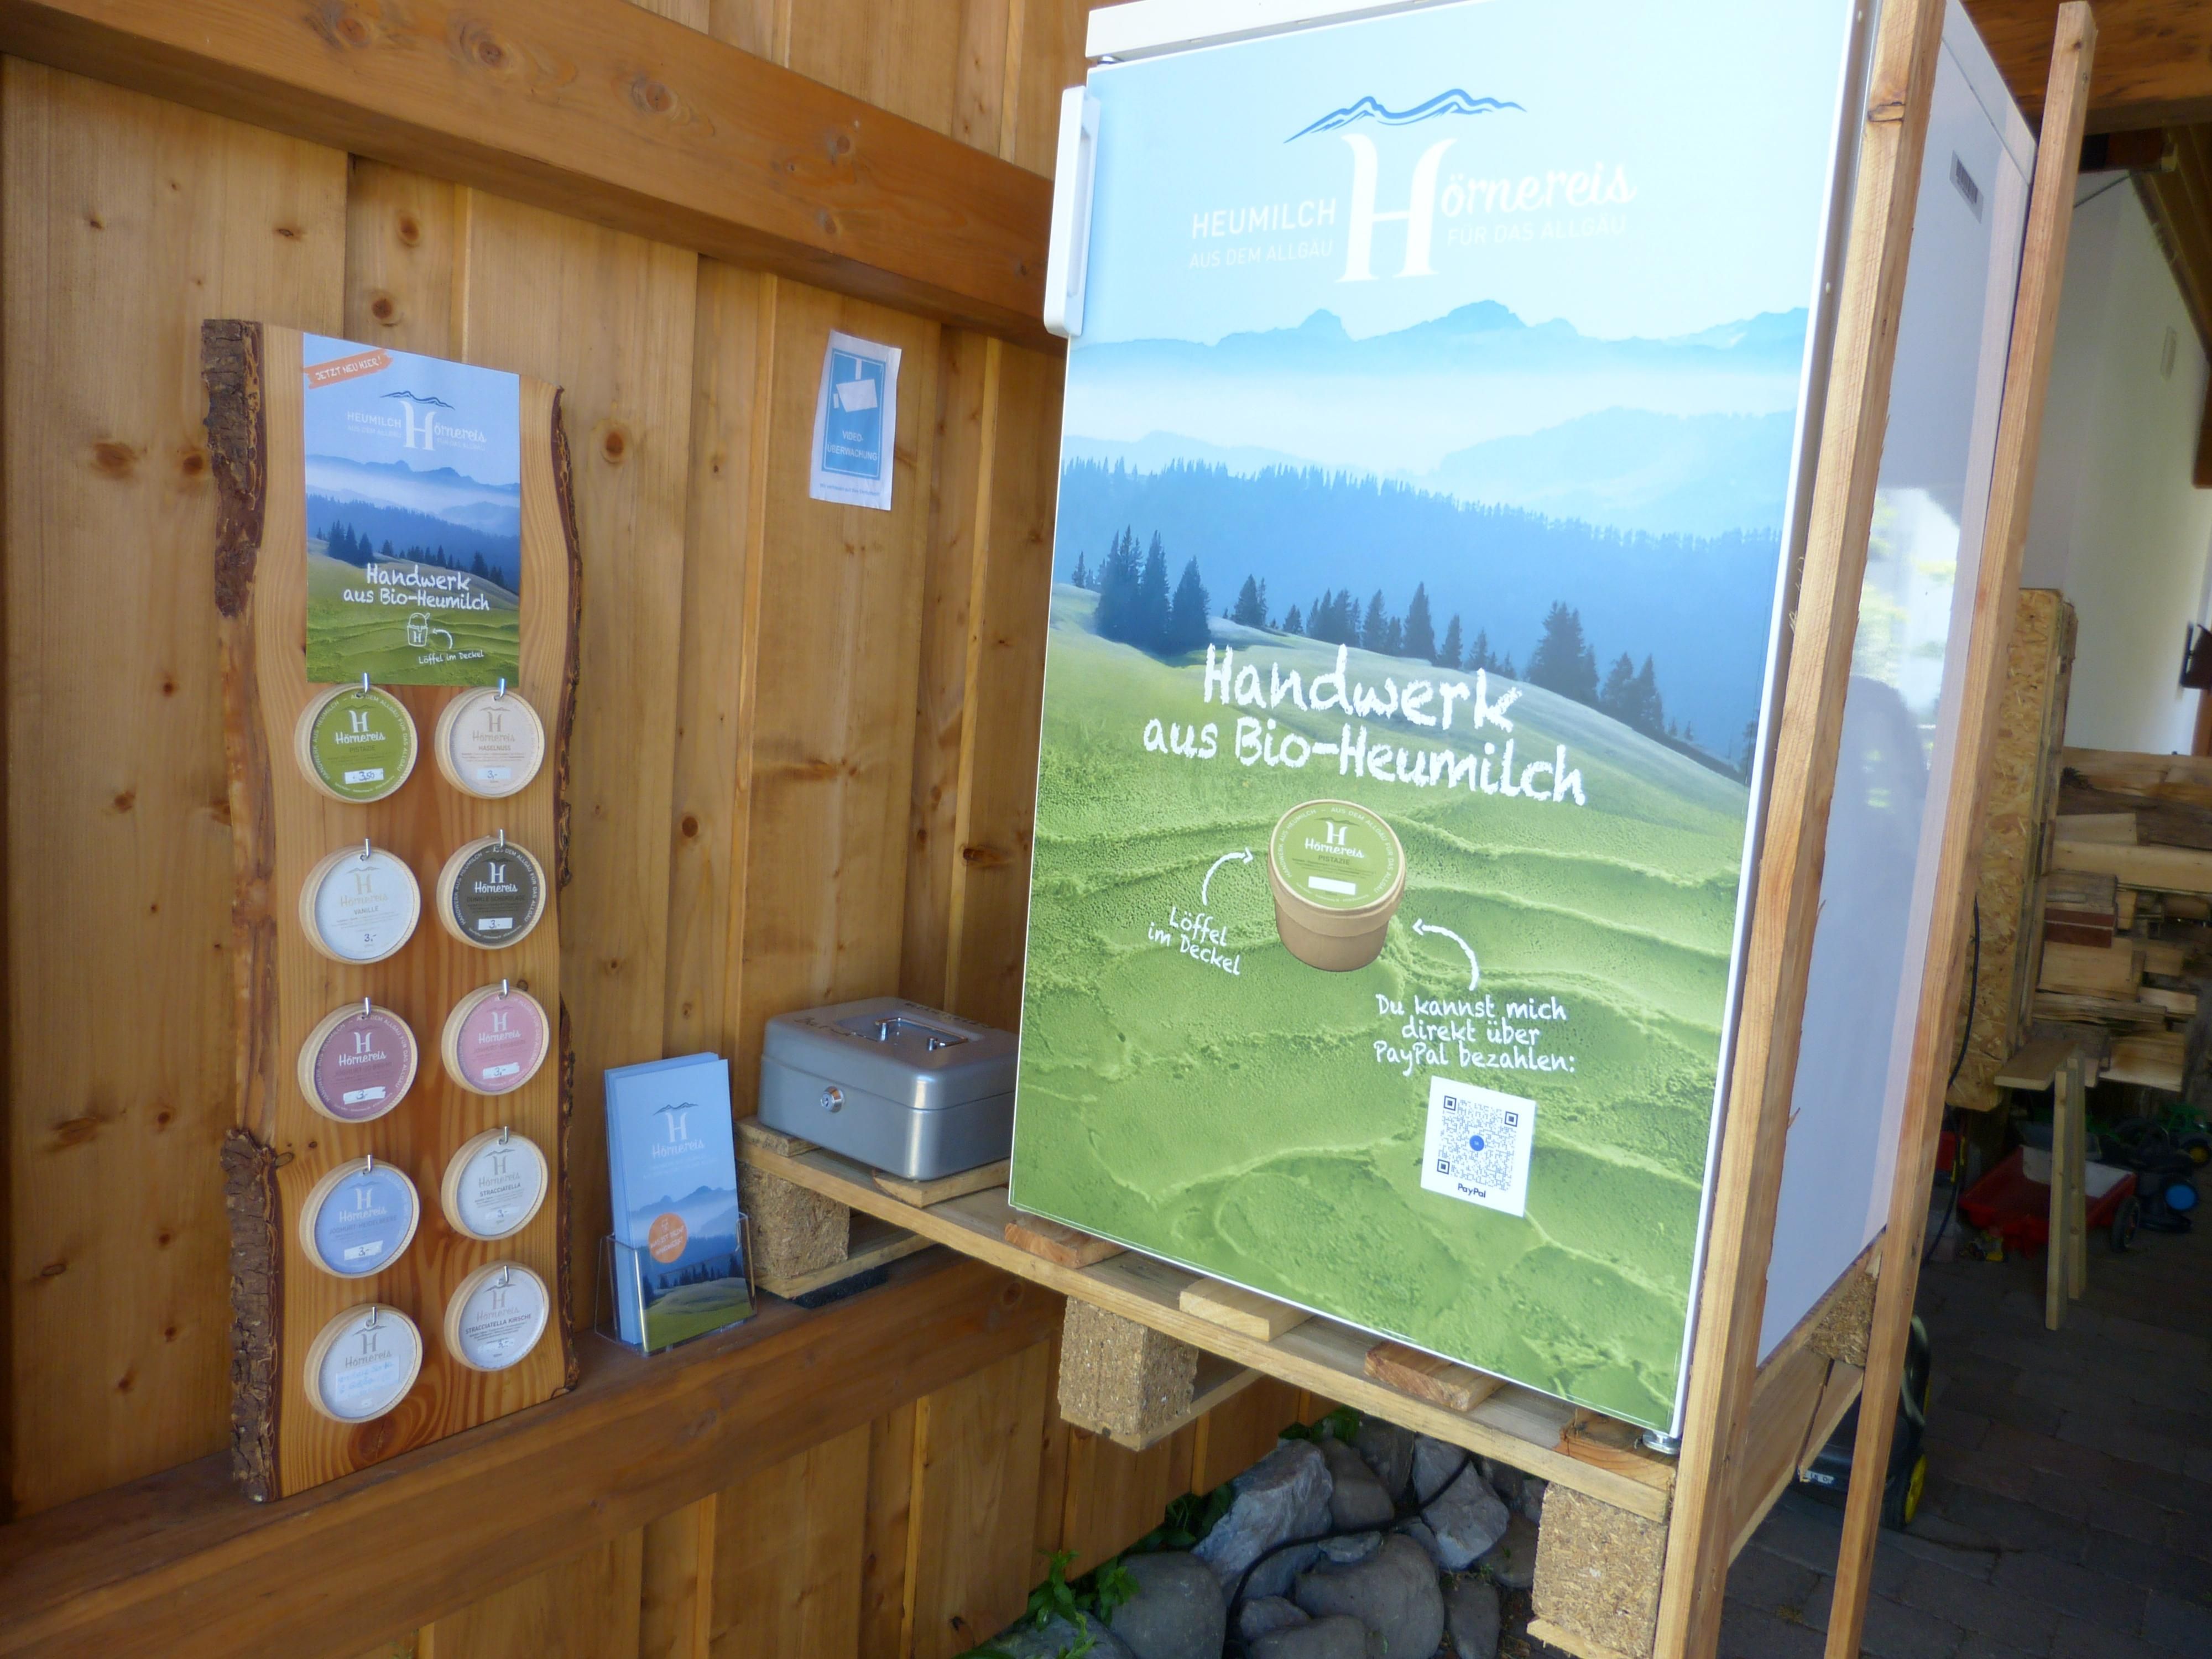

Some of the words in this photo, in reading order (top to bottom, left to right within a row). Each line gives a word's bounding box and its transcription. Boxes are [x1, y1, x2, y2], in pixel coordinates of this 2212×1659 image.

[1192, 197, 1337, 239] HEUMILCH
[1447, 226, 1485, 247] FÜR
[1494, 221, 1534, 244] DAS
[1541, 214, 1626, 239] ALLGÄU
[1189, 250, 1221, 269] AUS
[1226, 247, 1261, 265] DEM
[1267, 239, 1333, 262] ALLGÄU
[315, 367, 341, 380] JETZT
[343, 363, 358, 374] NEU
[359, 356, 382, 369] HIER!
[347, 411, 401, 429] HEUMILCH
[842, 430, 864, 442] VIDEO-
[827, 444, 877, 461] ÜBERWACHUNG
[367, 563, 471, 591] Handwerk
[343, 589, 374, 603] aus
[380, 588, 489, 611] Bio-Heumilch
[419, 653, 442, 665] Löffel
[459, 650, 484, 659] Deckel
[1203, 643, 1522, 733] Handwerk
[349, 710, 369, 733] H
[487, 712, 503, 732] H
[1143, 718, 1218, 760] aus
[1234, 717, 1585, 806] Bio-Heumilch
[1325, 821, 1348, 846] H
[1318, 855, 1350, 865] PISTAZIE
[355, 873, 372, 894] H
[489, 862, 506, 883] H
[353, 905, 379, 915] VANILLE
[1169, 906, 1228, 946] Löffel
[1148, 922, 1170, 946] im
[1180, 933, 1240, 976] Deckel
[1375, 993, 1404, 1015] Du
[1414, 994, 1495, 1018] kannst
[1506, 996, 1567, 1020] mich
[492, 1011, 508, 1032] H
[1401, 1015, 1476, 1042] direkt
[1486, 1017, 1540, 1046] über
[354, 1032, 373, 1054] H
[1373, 1040, 1448, 1077] PayPal
[1458, 1040, 1575, 1072] bezahlen:
[665, 1112, 688, 1143] H
[493, 1156, 508, 1175] H
[355, 1187, 373, 1210] H
[479, 1182, 521, 1197] STRACCIATELLA
[1457, 1183, 1486, 1198] PayPal
[492, 1290, 507, 1310] H
[466, 1319, 507, 1335] STRACCIATELLA
[508, 1313, 532, 1323] KIRSCHE
[362, 1333, 378, 1354] H
